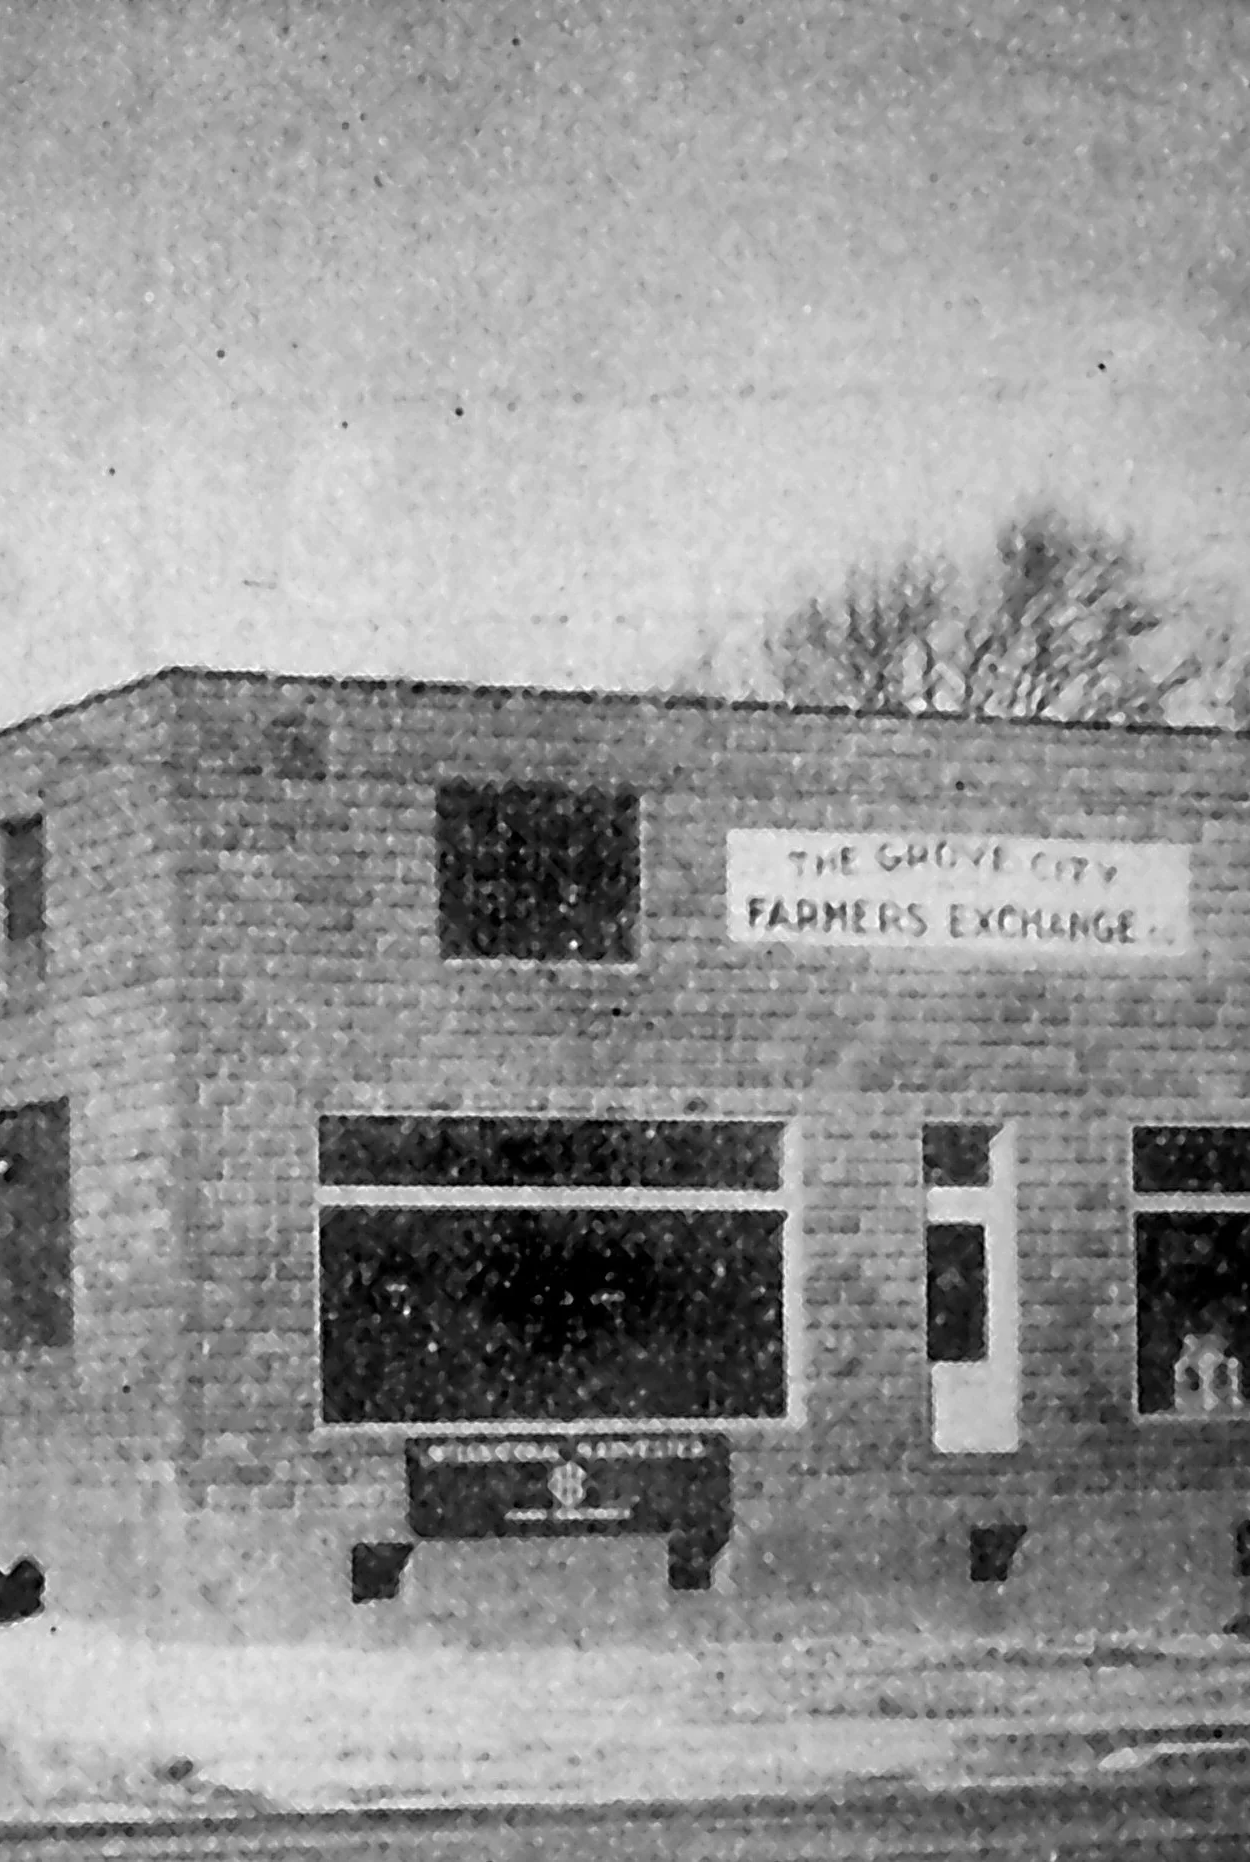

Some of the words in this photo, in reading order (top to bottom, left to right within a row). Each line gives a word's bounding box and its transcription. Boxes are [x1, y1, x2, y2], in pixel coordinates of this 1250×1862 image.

[788, 846, 853, 877] THE
[874, 840, 1004, 873] GROVE
[1029, 850, 1118, 885] CITY
[749, 898, 928, 938] FARMERS
